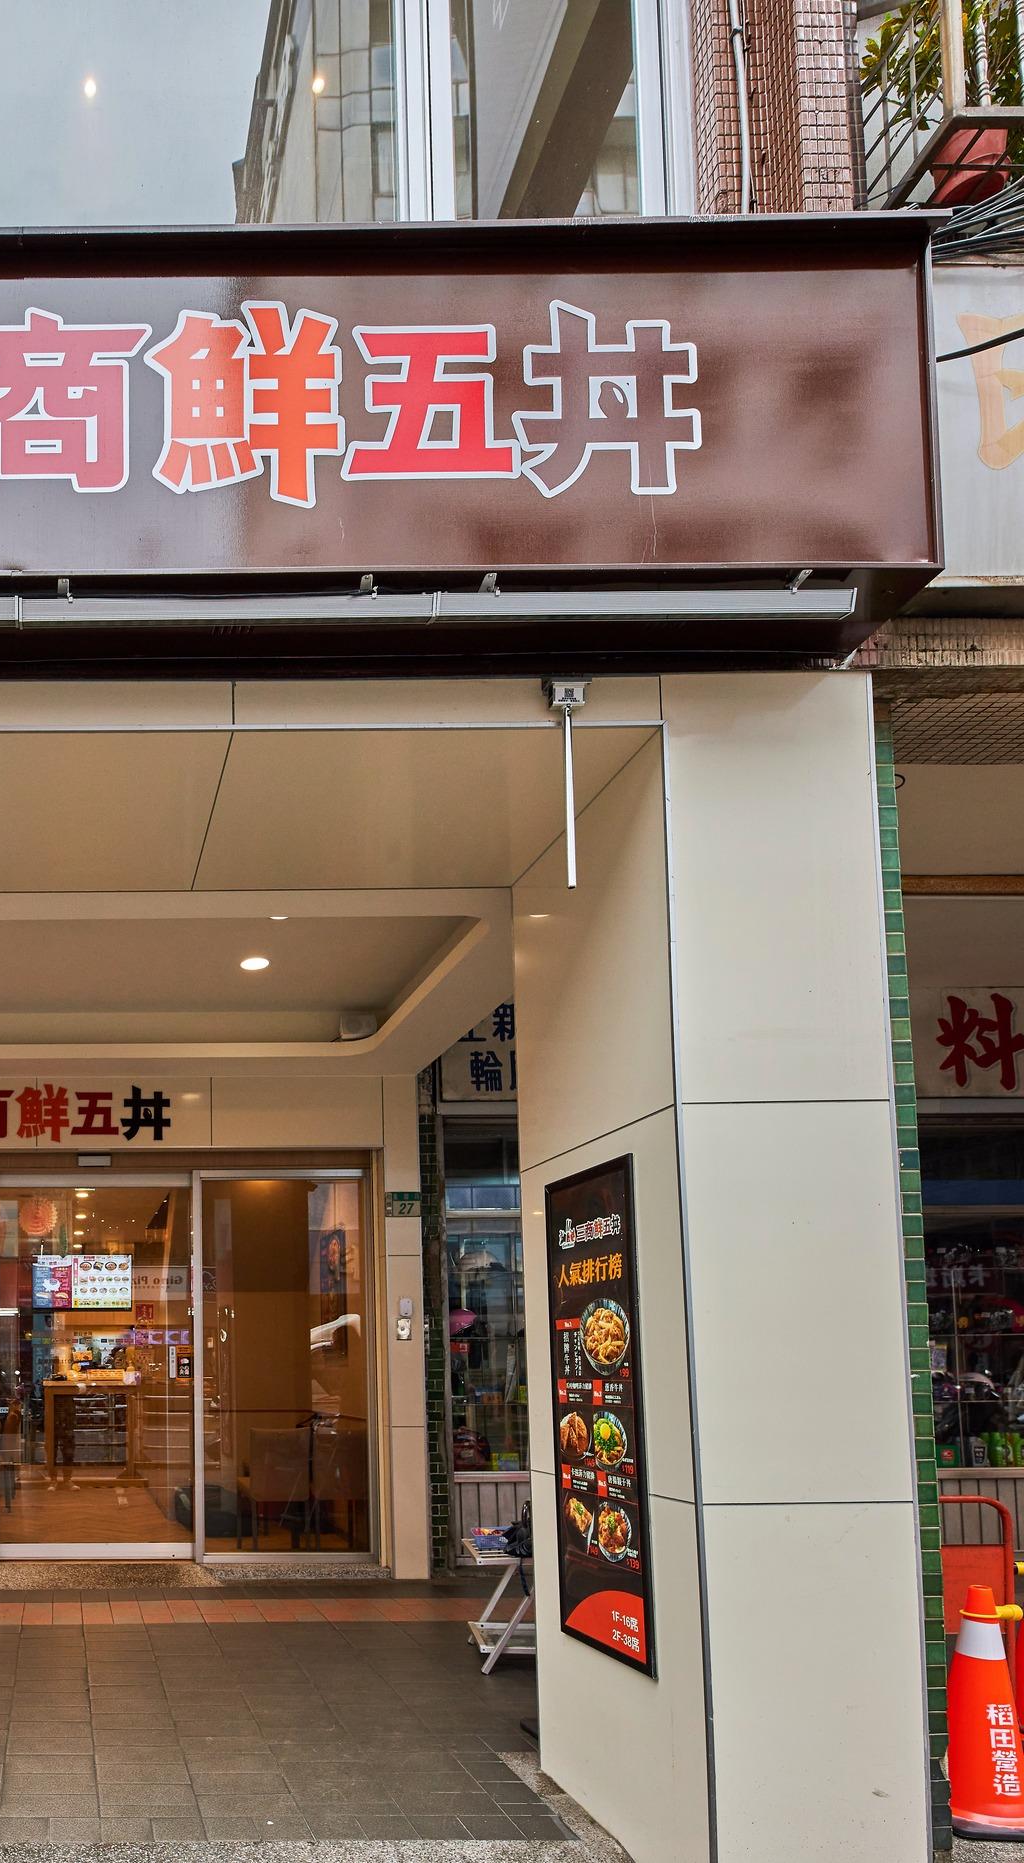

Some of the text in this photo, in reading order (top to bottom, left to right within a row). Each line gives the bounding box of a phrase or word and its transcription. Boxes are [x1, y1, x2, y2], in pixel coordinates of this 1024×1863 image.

[936, 993, 1024, 1090] 料
[399, 1203, 414, 1215] 27
[576, 1214, 621, 1242] 三商鮮五丼
[558, 1253, 622, 1288] 人氣排行榜
[611, 1610, 639, 1633] 1F-16席
[612, 1629, 640, 1653] 2F-38席
[986, 1703, 1022, 1797] 稻田營造
